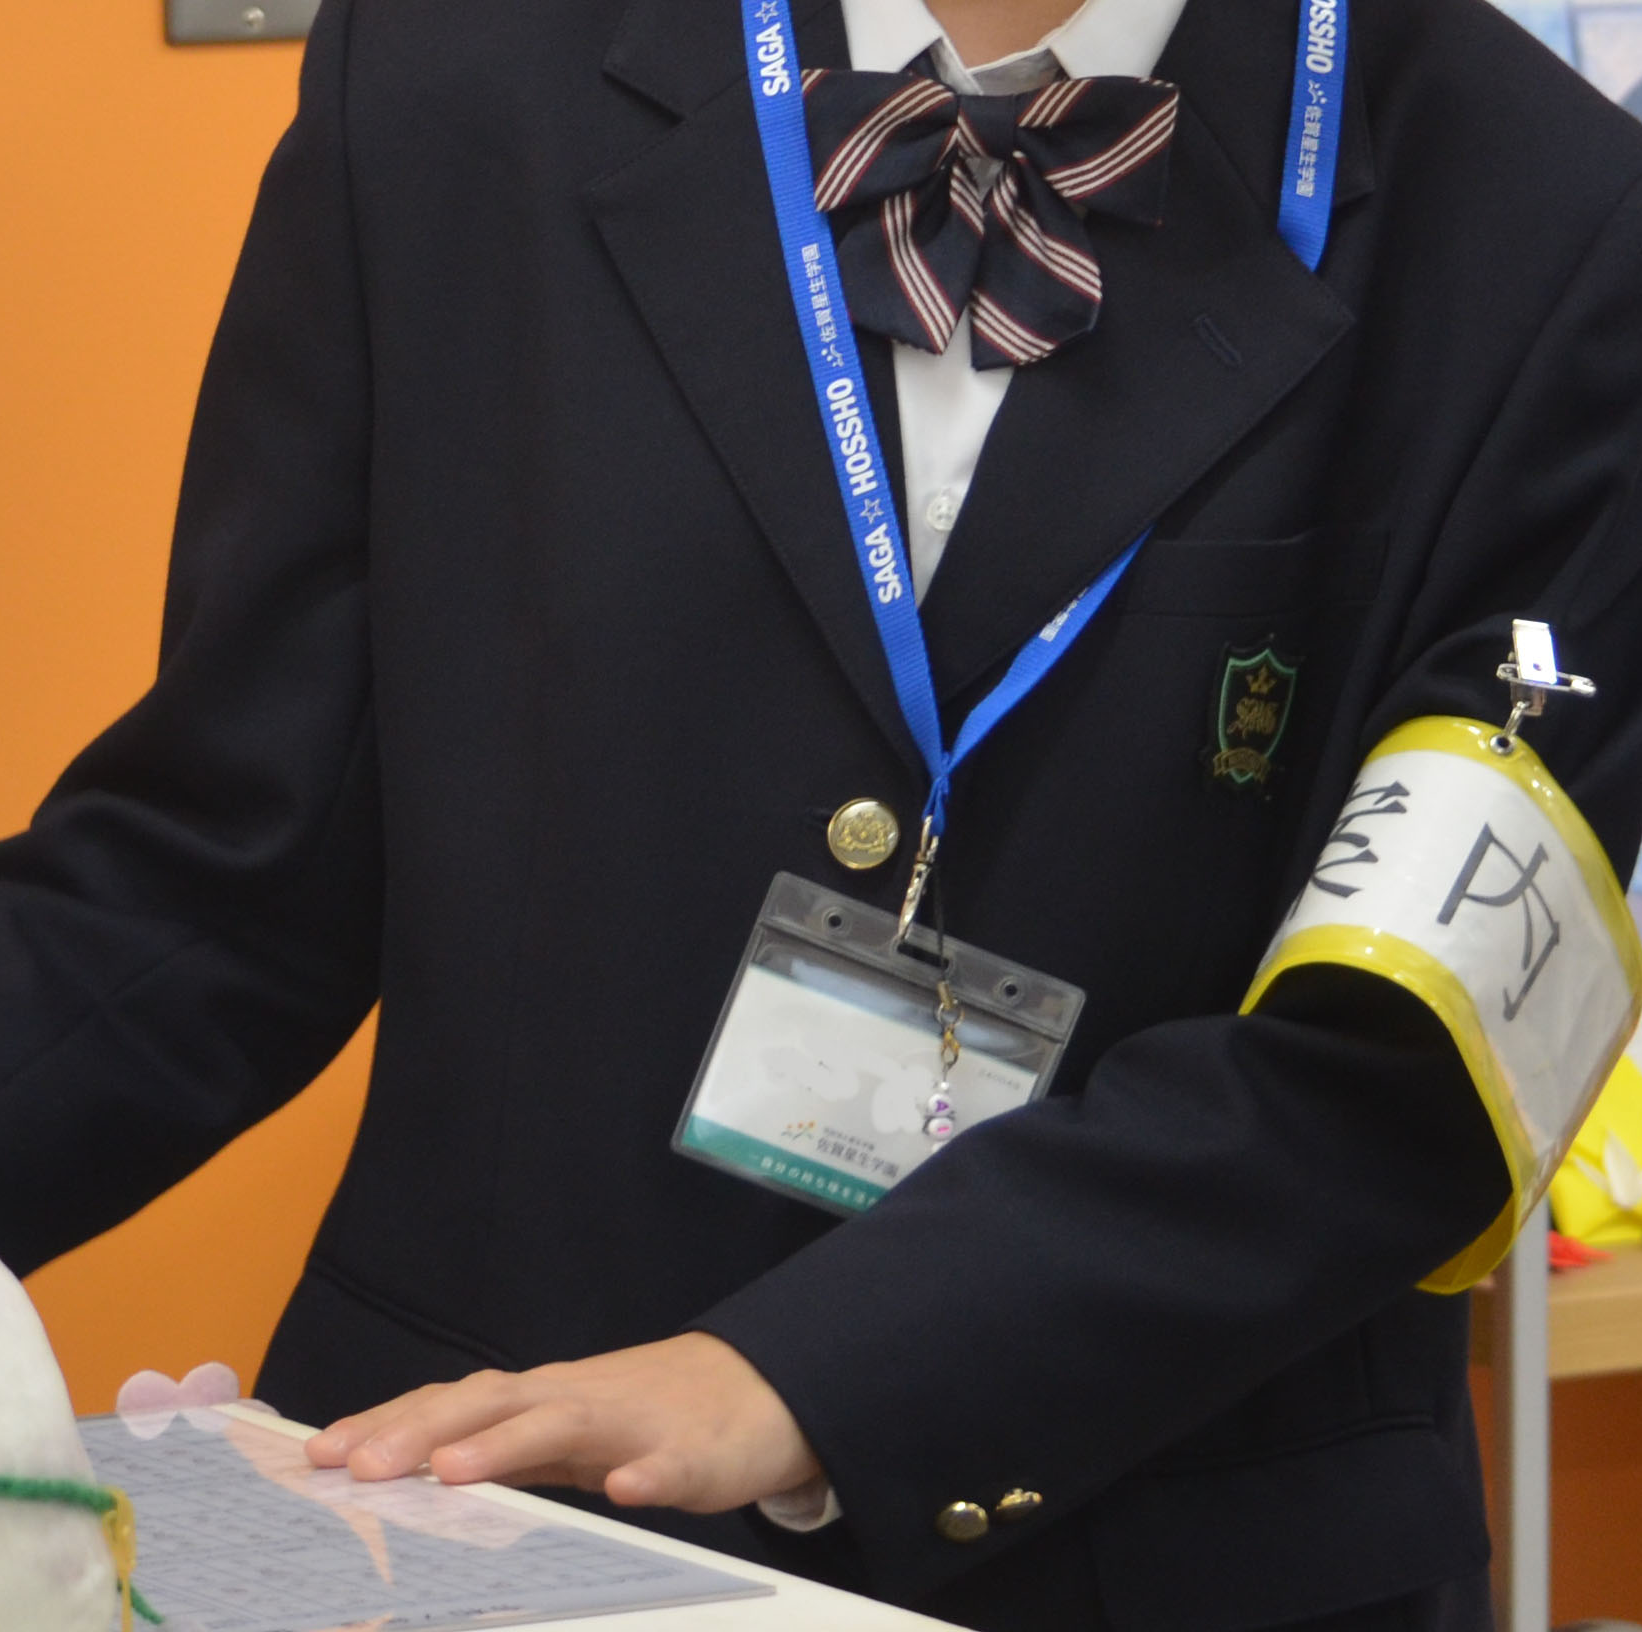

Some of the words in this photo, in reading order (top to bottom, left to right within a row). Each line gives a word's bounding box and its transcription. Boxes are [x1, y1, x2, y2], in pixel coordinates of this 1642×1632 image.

[755, 22, 791, 97] SAGA
[801, 243, 837, 343] 佐賀星生学園
[825, 377, 878, 497] HOSSHO
[864, 522, 902, 604] SAGA
